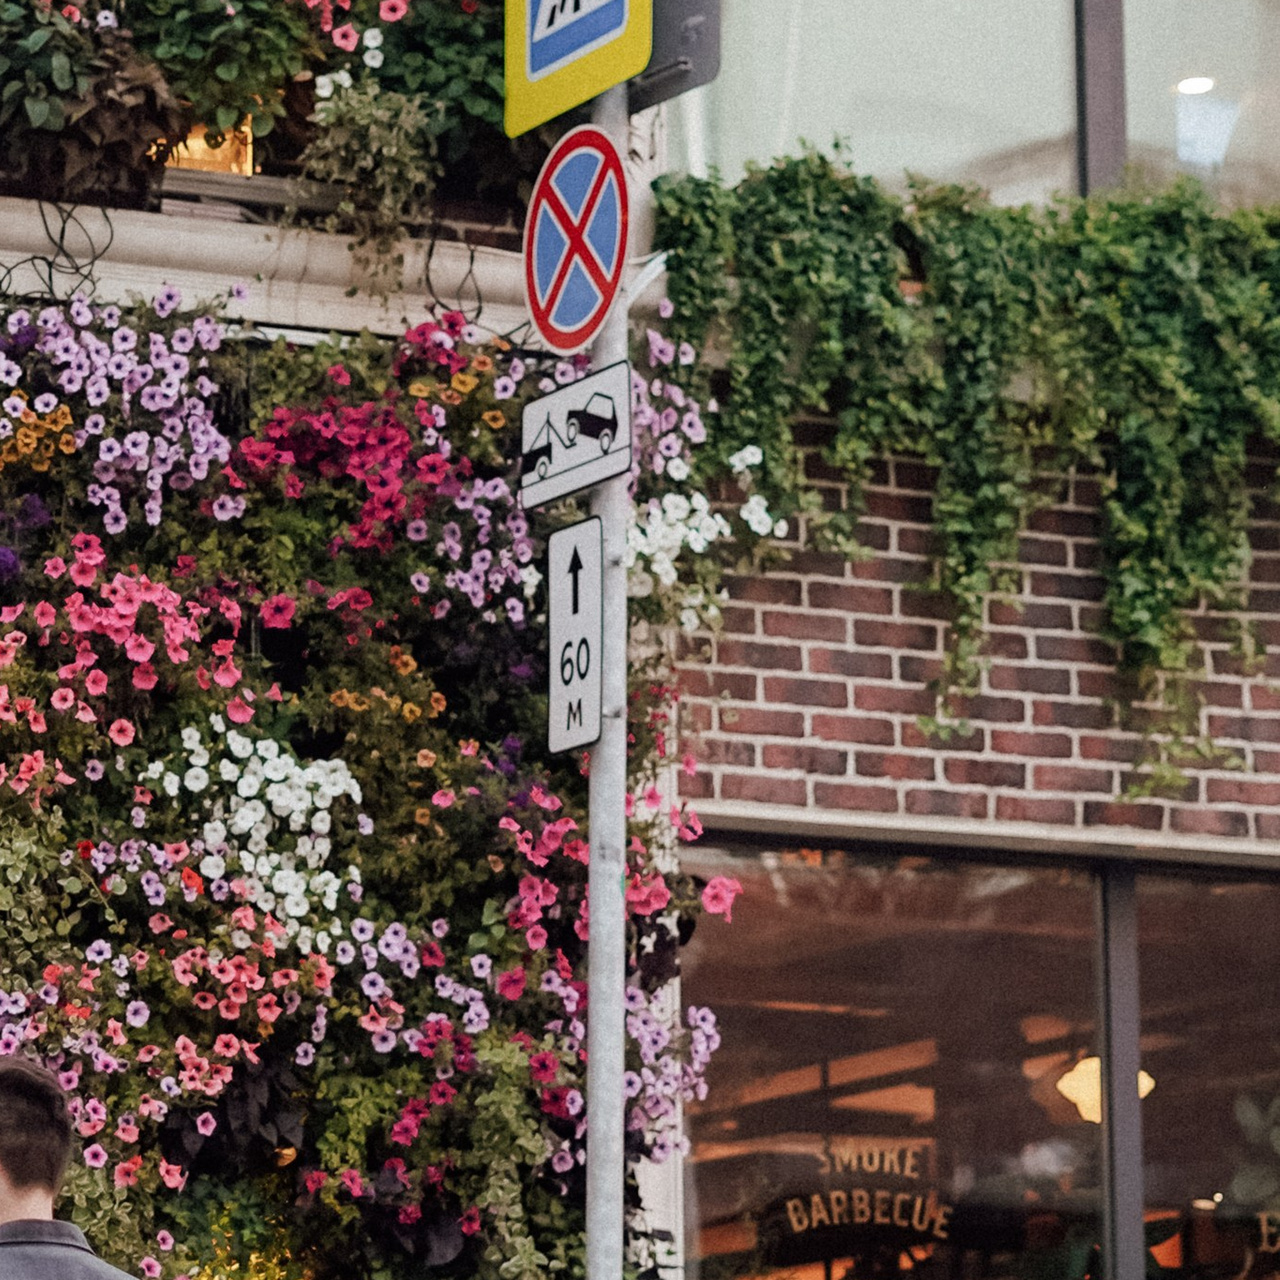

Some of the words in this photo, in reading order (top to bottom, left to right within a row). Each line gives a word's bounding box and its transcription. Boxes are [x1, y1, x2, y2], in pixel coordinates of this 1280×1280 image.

[560, 637, 590, 686] 60
[819, 1140, 921, 1180] SMOKE
[785, 1187, 954, 1240] BARBECUE
